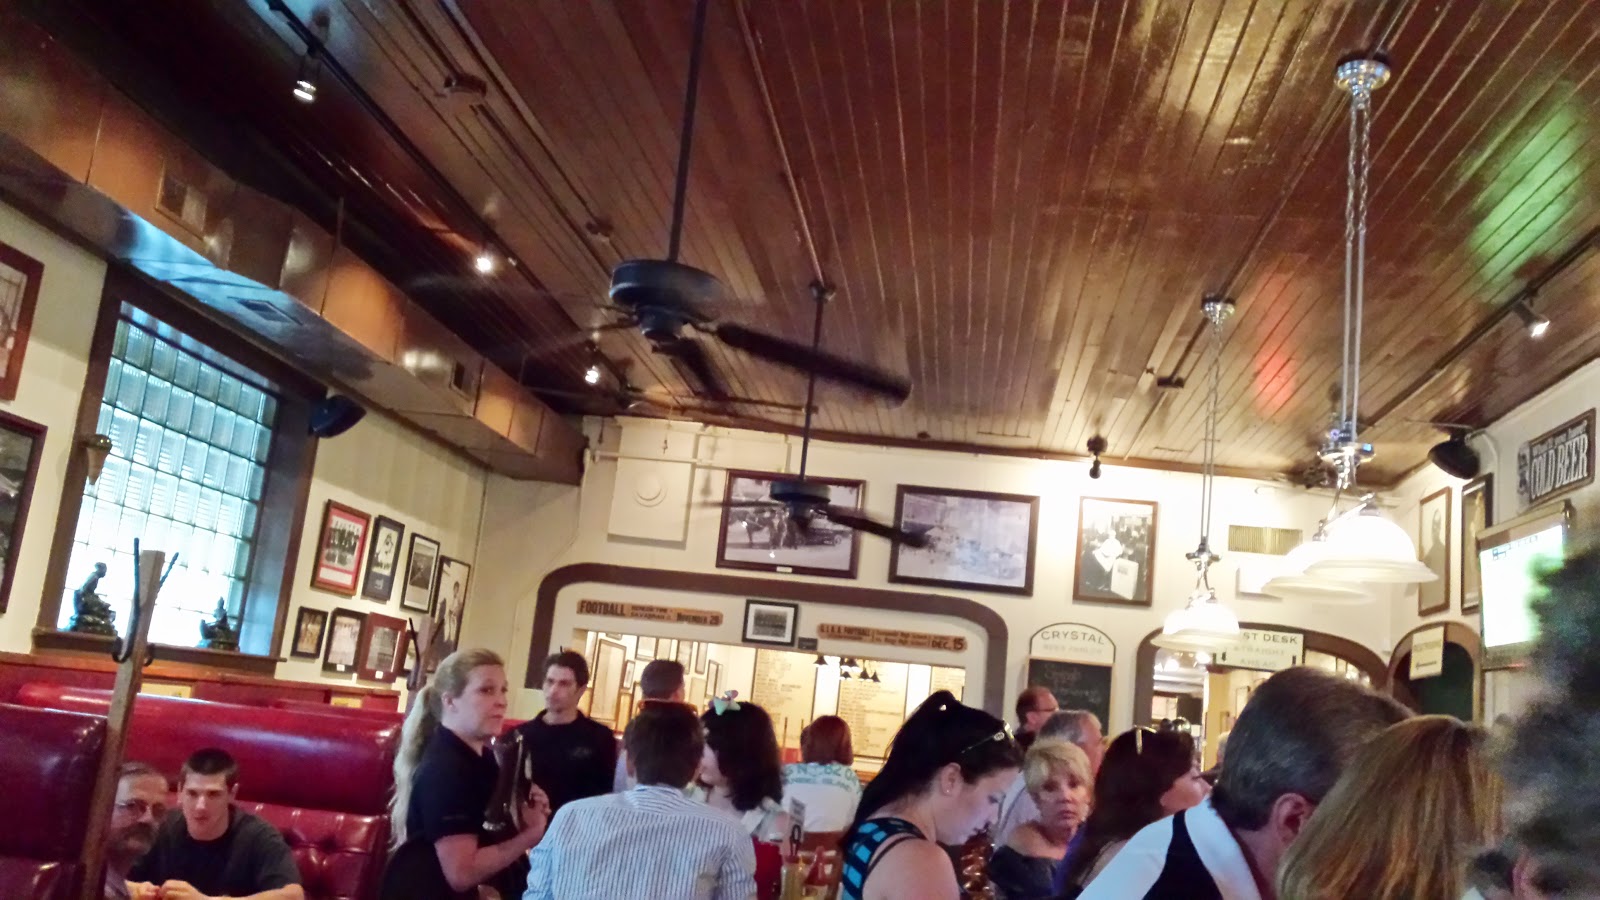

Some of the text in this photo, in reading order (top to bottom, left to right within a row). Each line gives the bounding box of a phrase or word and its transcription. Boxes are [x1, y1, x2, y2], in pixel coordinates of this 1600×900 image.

[1530, 448, 1556, 500] COLD
[1555, 433, 1589, 488] BEER
[580, 600, 626, 617] FOOTBALL
[1041, 630, 1105, 645] CRYSTAL
[1263, 633, 1297, 644] DESK
